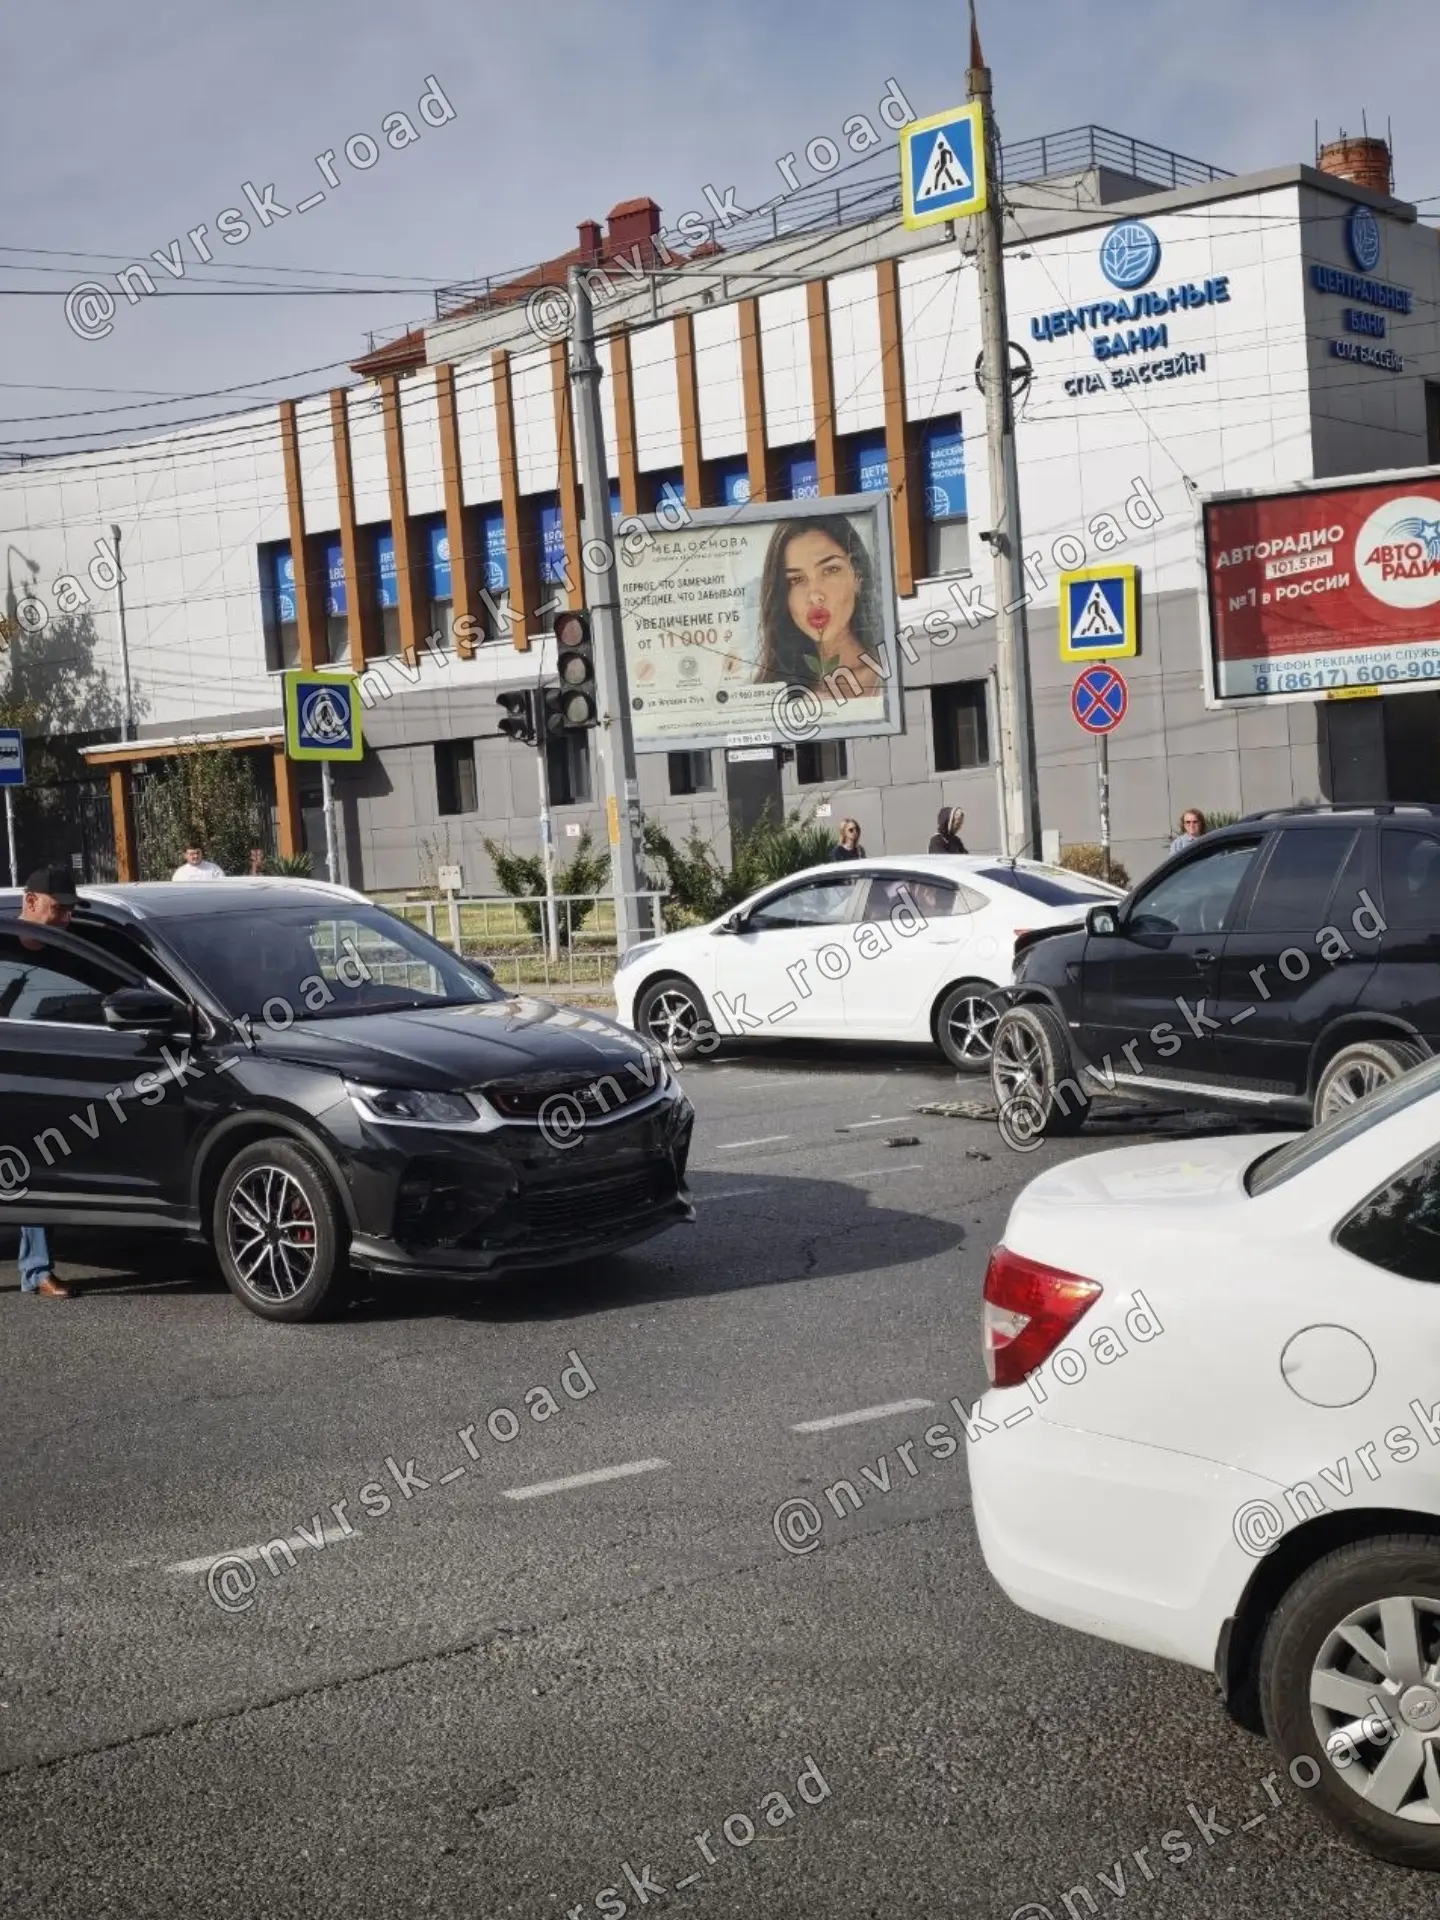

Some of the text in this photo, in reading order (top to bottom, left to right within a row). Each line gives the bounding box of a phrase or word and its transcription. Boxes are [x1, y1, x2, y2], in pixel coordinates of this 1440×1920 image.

[1312, 265, 1414, 314] ЦЕНТРАЛЬНЫЕ
[1030, 276, 1231, 343] ЦЕНТРАЛЬНЫЕ
[1347, 309, 1386, 338] БАНИ
[1092, 323, 1169, 361] БАНИ
[1334, 340, 1358, 359] СПА
[1064, 351, 1206, 398] СПА БАССЕЙН
[1215, 525, 1345, 570] АВТОРАДИО
[1364, 542, 1422, 566] АВТО
[659, 579, 675, 590] ЧТО
[677, 574, 725, 588] ЗАМЕЧАЮТ
[677, 591, 695, 602] ЧТО
[698, 587, 746, 601] ЗАБЫВАЮТ
[1262, 592, 1272, 606] в
[1276, 572, 1350, 601] РОССИИ
[636, 610, 740, 630] УВЕЛИЧЕНИЕ ГУБ
[1252, 661, 1312, 675] ТЕЛЕФОН
[1256, 676, 1269, 693] 8
[1277, 668, 1349, 692] (8617)
